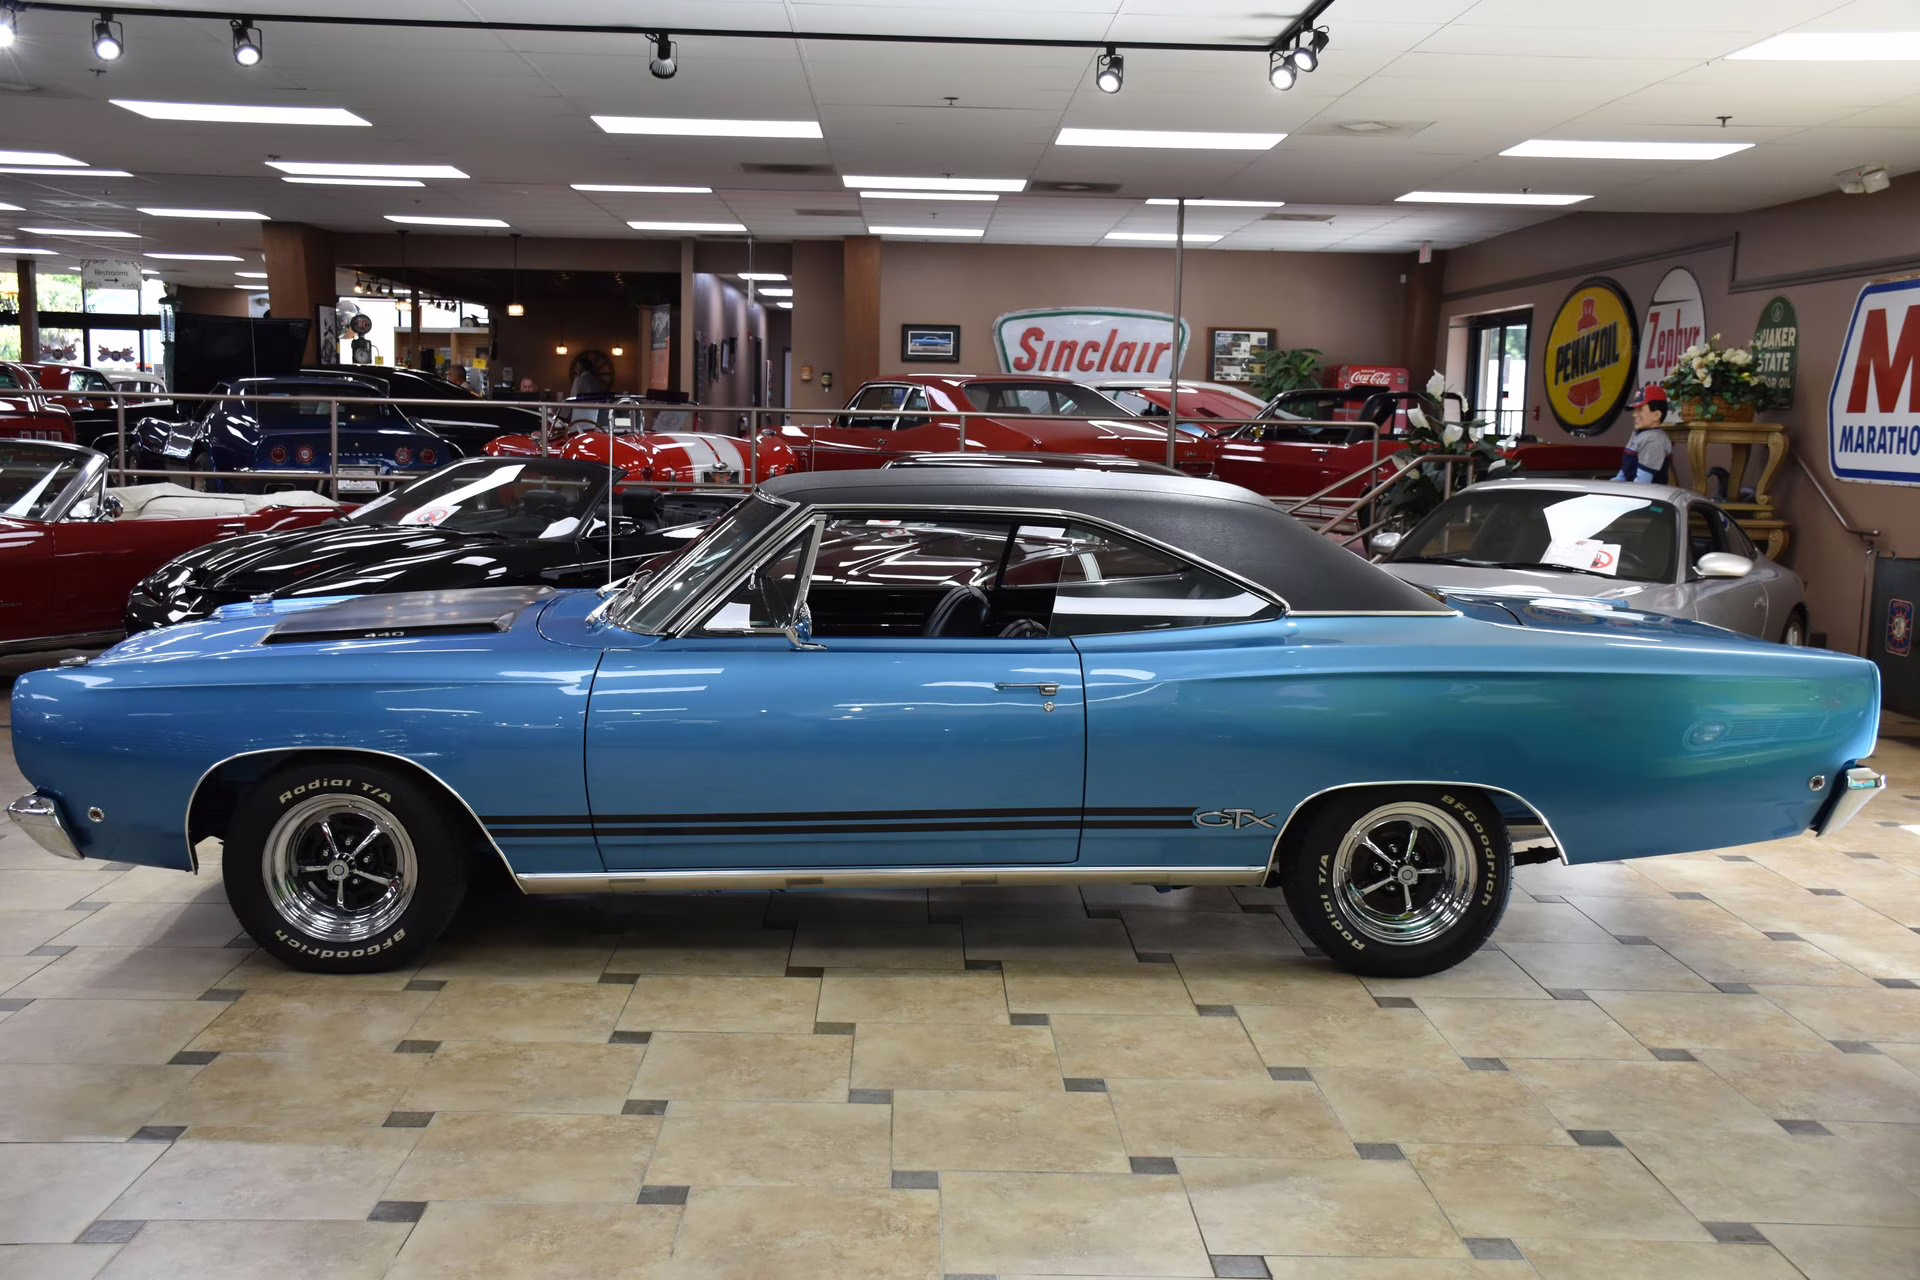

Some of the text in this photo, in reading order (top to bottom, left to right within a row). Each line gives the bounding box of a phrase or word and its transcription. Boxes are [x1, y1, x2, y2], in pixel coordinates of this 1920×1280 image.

[94, 269, 129, 277] Restrooms
[1013, 326, 1172, 374] Sinclair
[1554, 320, 1620, 386] PENNZOIL
[1645, 308, 1701, 377] Zephyr
[1757, 327, 1797, 348] UAKER
[1350, 371, 1392, 385] Coca-Cola
[1846, 304, 1920, 414] M
[279, 778, 392, 804] Radial T/A
[1196, 808, 1278, 830] GTX
[1441, 794, 1496, 906] BFGoodrich
[1319, 854, 1366, 951] Radial T/A
[275, 928, 406, 959] BFGoodrich
